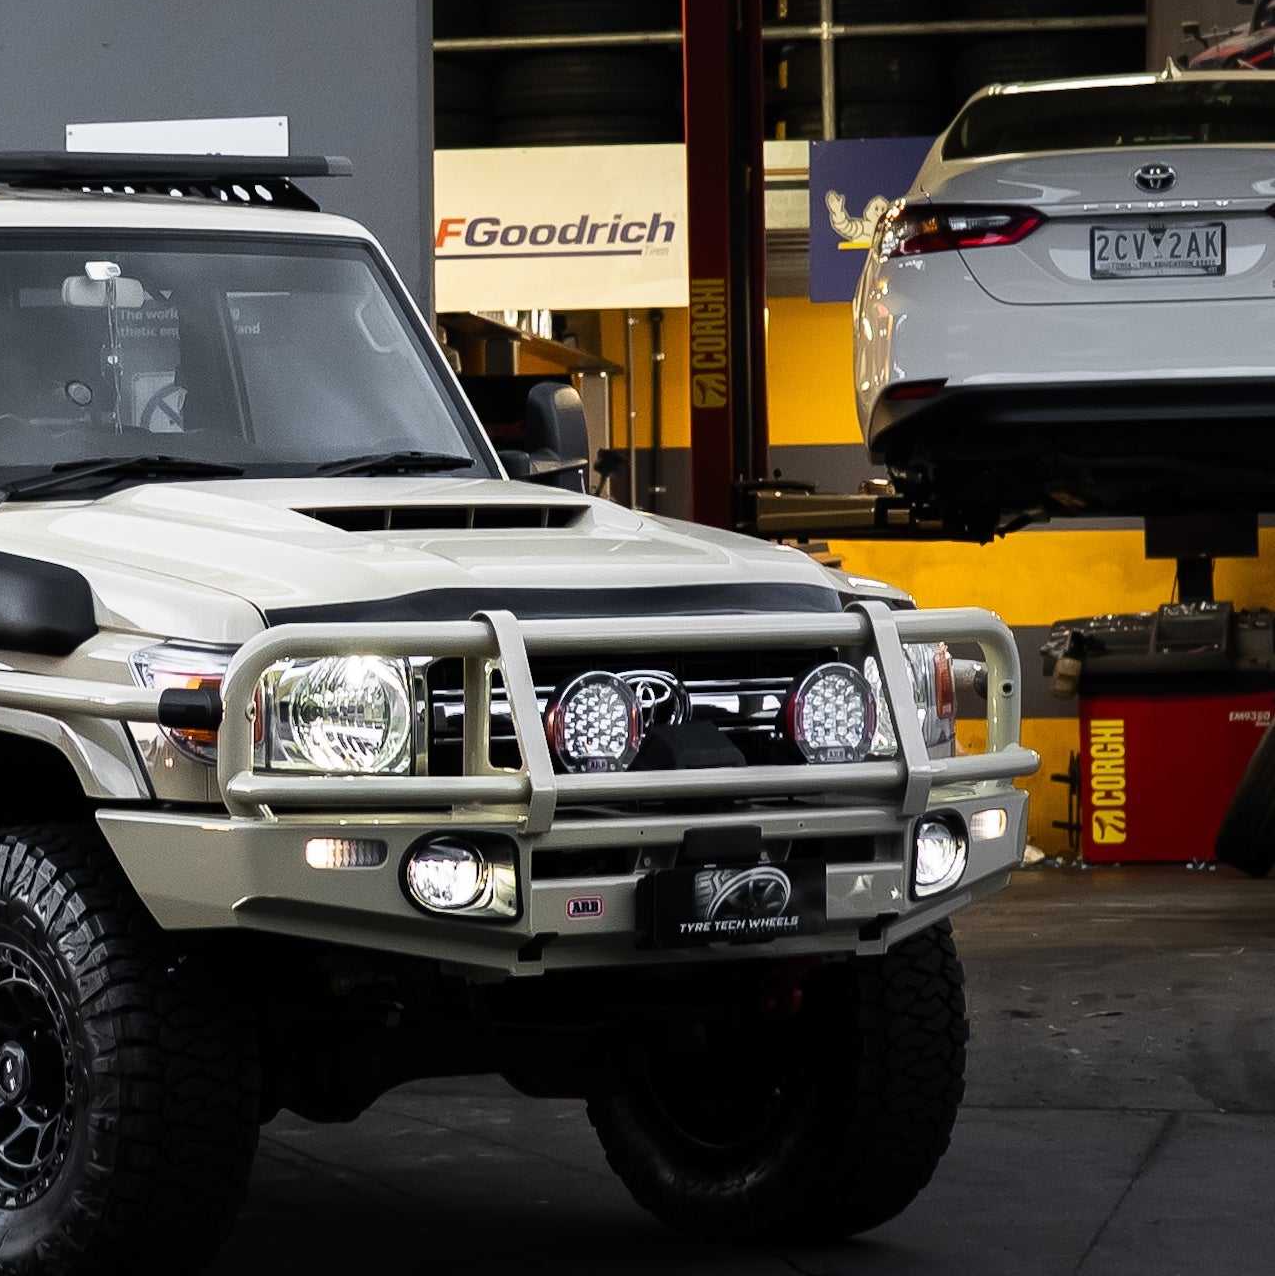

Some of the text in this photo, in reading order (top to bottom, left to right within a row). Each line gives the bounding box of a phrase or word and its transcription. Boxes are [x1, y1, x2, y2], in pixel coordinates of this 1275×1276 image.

[435, 212, 675, 248] FGoodrich
[691, 279, 726, 369] CORGHI
[1090, 719, 1126, 806] CORGHI
[572, 899, 599, 913] ARB
[680, 921, 711, 934] TYRE
[714, 919, 745, 932] TECH
[748, 915, 800, 929] WHEELS
